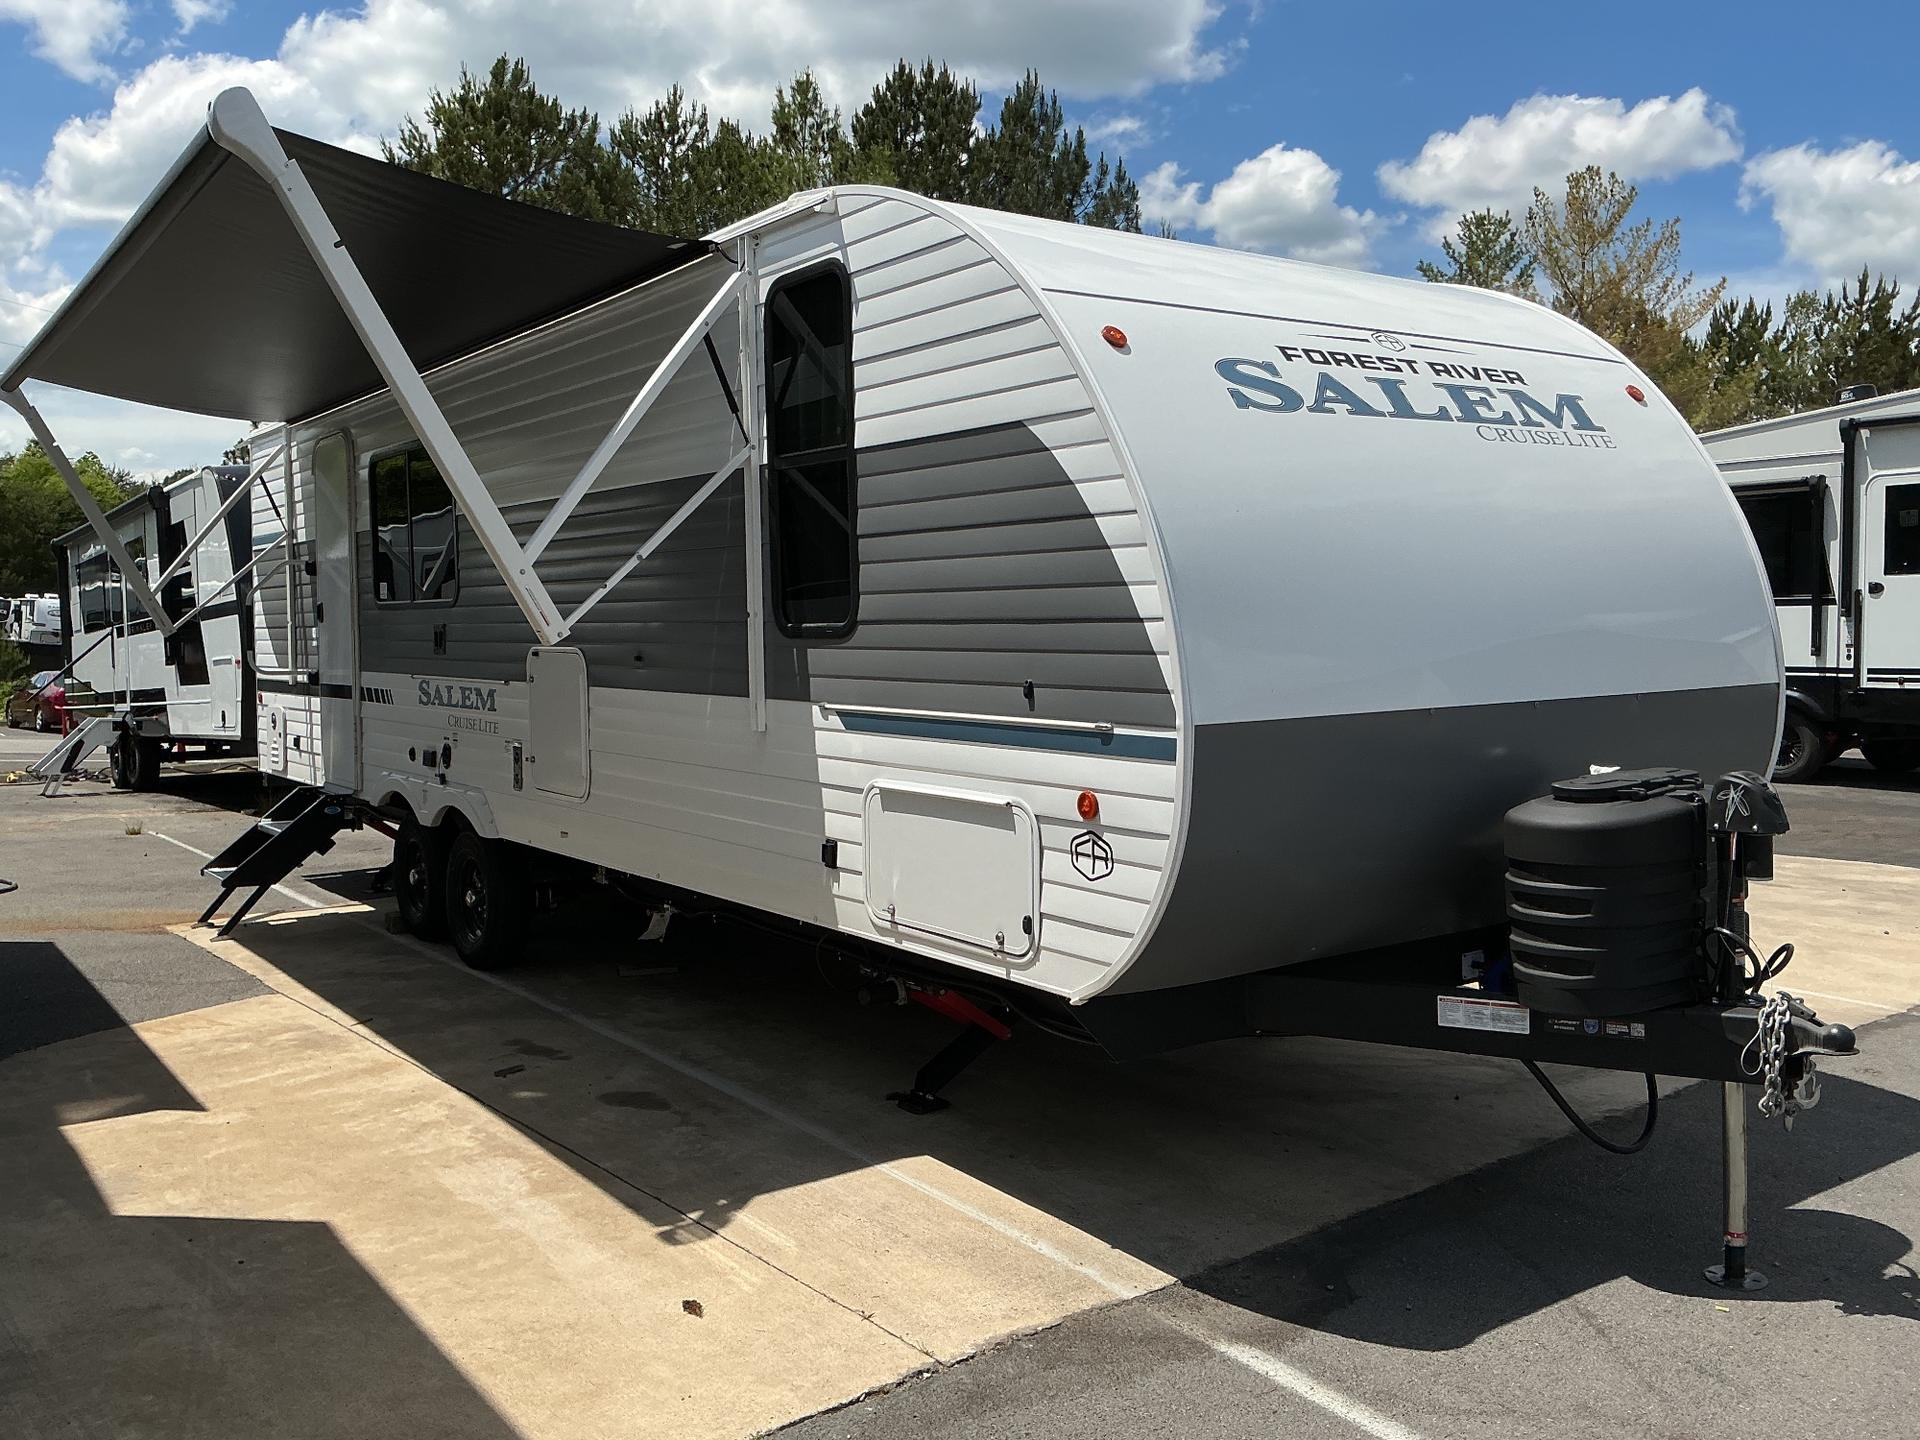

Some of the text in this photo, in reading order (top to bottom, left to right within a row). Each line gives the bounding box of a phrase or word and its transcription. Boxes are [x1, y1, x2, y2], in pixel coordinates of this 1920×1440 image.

[1275, 345, 1529, 386] FOREST RIVER
[1214, 357, 1607, 432] SALEM
[418, 679, 497, 712] SALEM
